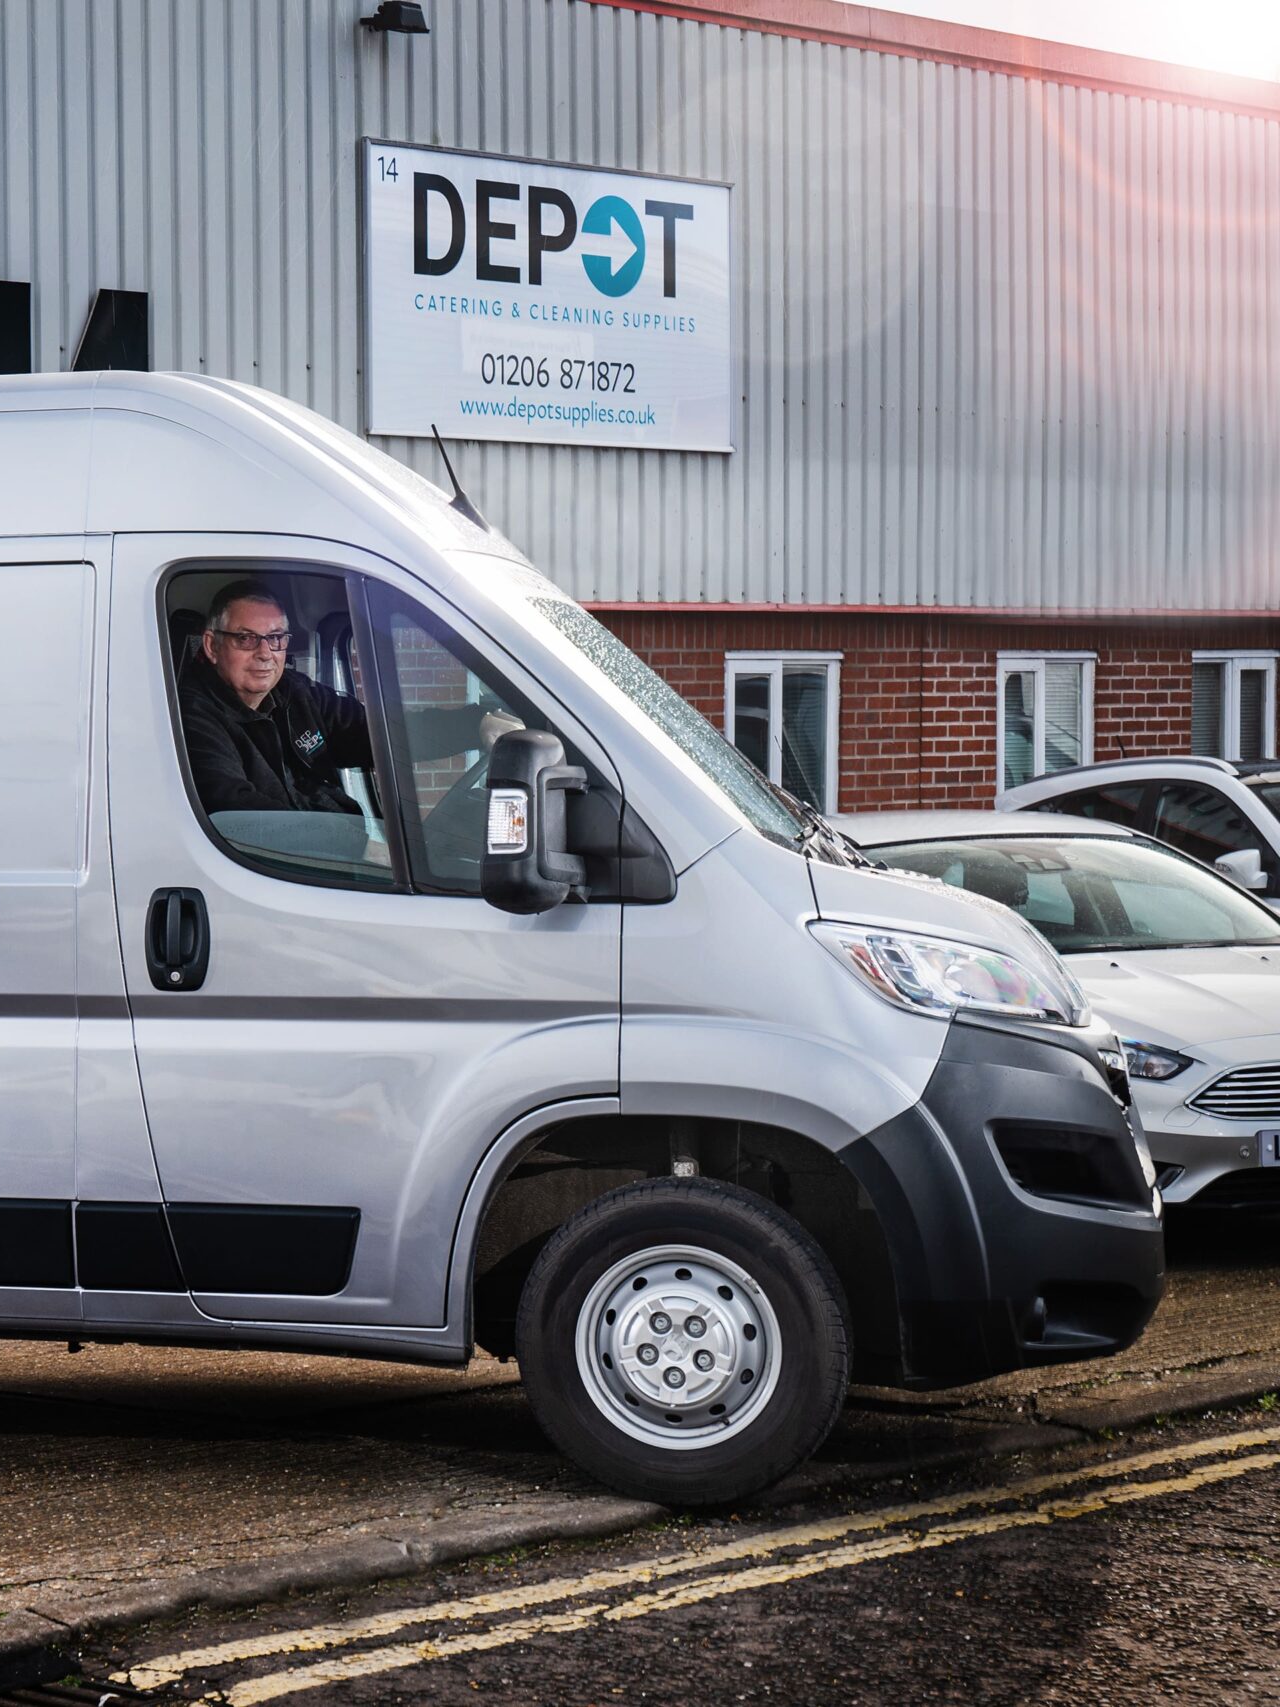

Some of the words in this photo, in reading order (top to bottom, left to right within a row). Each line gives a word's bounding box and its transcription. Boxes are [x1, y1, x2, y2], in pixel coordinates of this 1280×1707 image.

[377, 156, 399, 182] 14
[413, 171, 694, 298] DEPOT
[415, 294, 503, 317] CATERING
[511, 302, 521, 318] &
[530, 303, 615, 326] CLEANING
[623, 312, 696, 333] SUPPLIES
[481, 353, 550, 388] 01206
[560, 359, 636, 394] 871872
[460, 397, 656, 428] www.depotsupplies.co.uk
